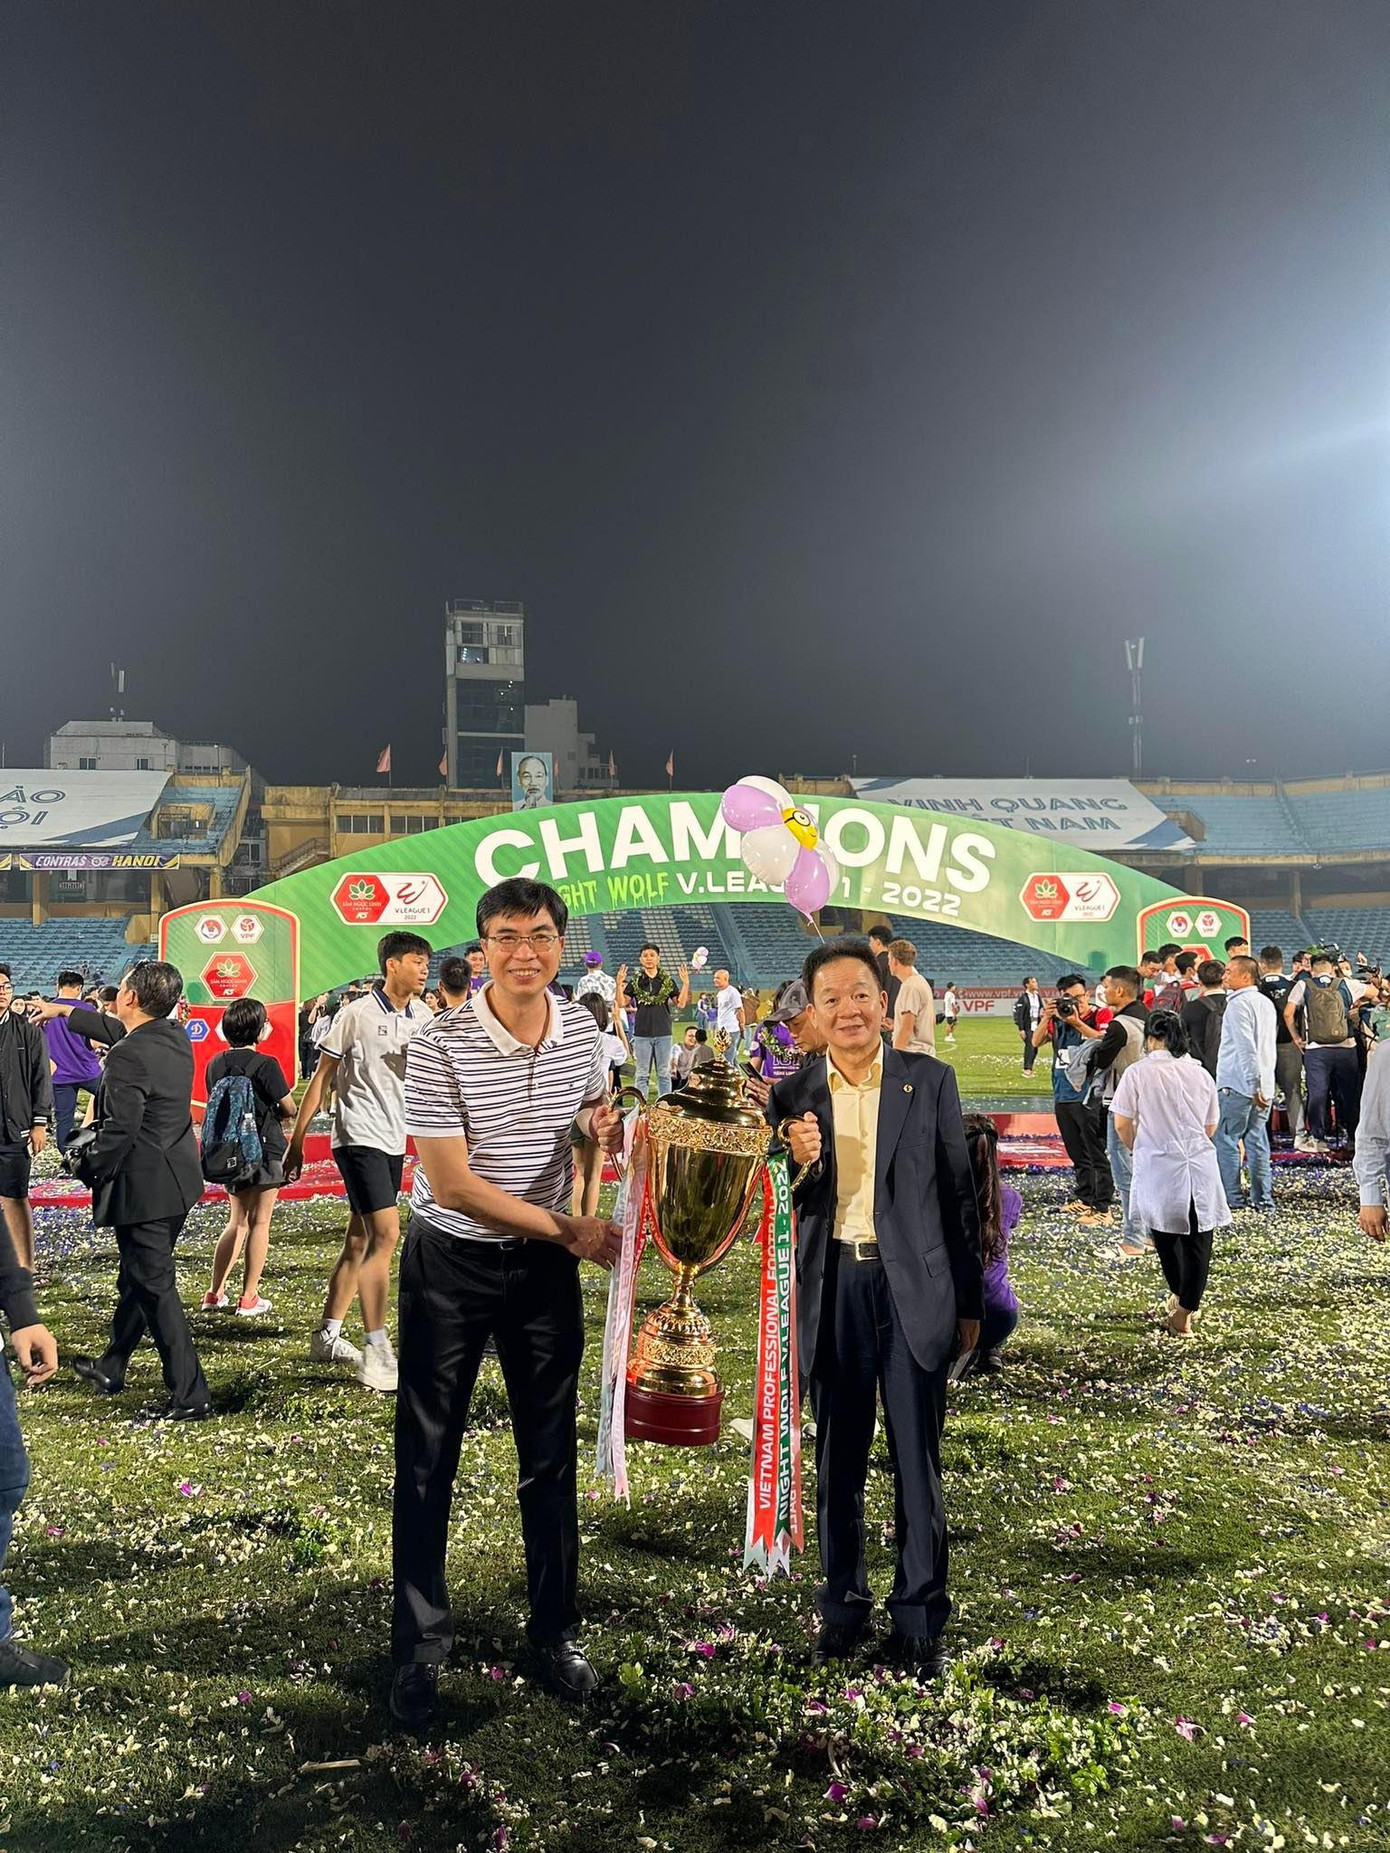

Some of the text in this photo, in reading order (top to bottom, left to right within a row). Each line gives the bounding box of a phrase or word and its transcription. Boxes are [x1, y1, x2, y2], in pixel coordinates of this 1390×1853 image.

[990, 797, 1129, 813] QUANG
[1023, 817, 1122, 831] NAM
[35, 854, 162, 868] CONTRAS HANOI
[474, 801, 997, 893] CHAMONS
[557, 880, 597, 913] GHT
[607, 872, 669, 910] WOLF
[676, 871, 785, 895] V.LEA
[841, 876, 851, 898] 1
[881, 881, 962, 917] 2022
[962, 1000, 995, 1012] VPF
[776, 1158, 790, 1215] 2022
[777, 1230, 790, 1243] 1
[763, 1282, 779, 1420] PROFESSIONAL
[780, 1367, 790, 1440] WOLF
[759, 1422, 775, 1510] VIETNAM
[778, 1443, 790, 1521] NIGHT
